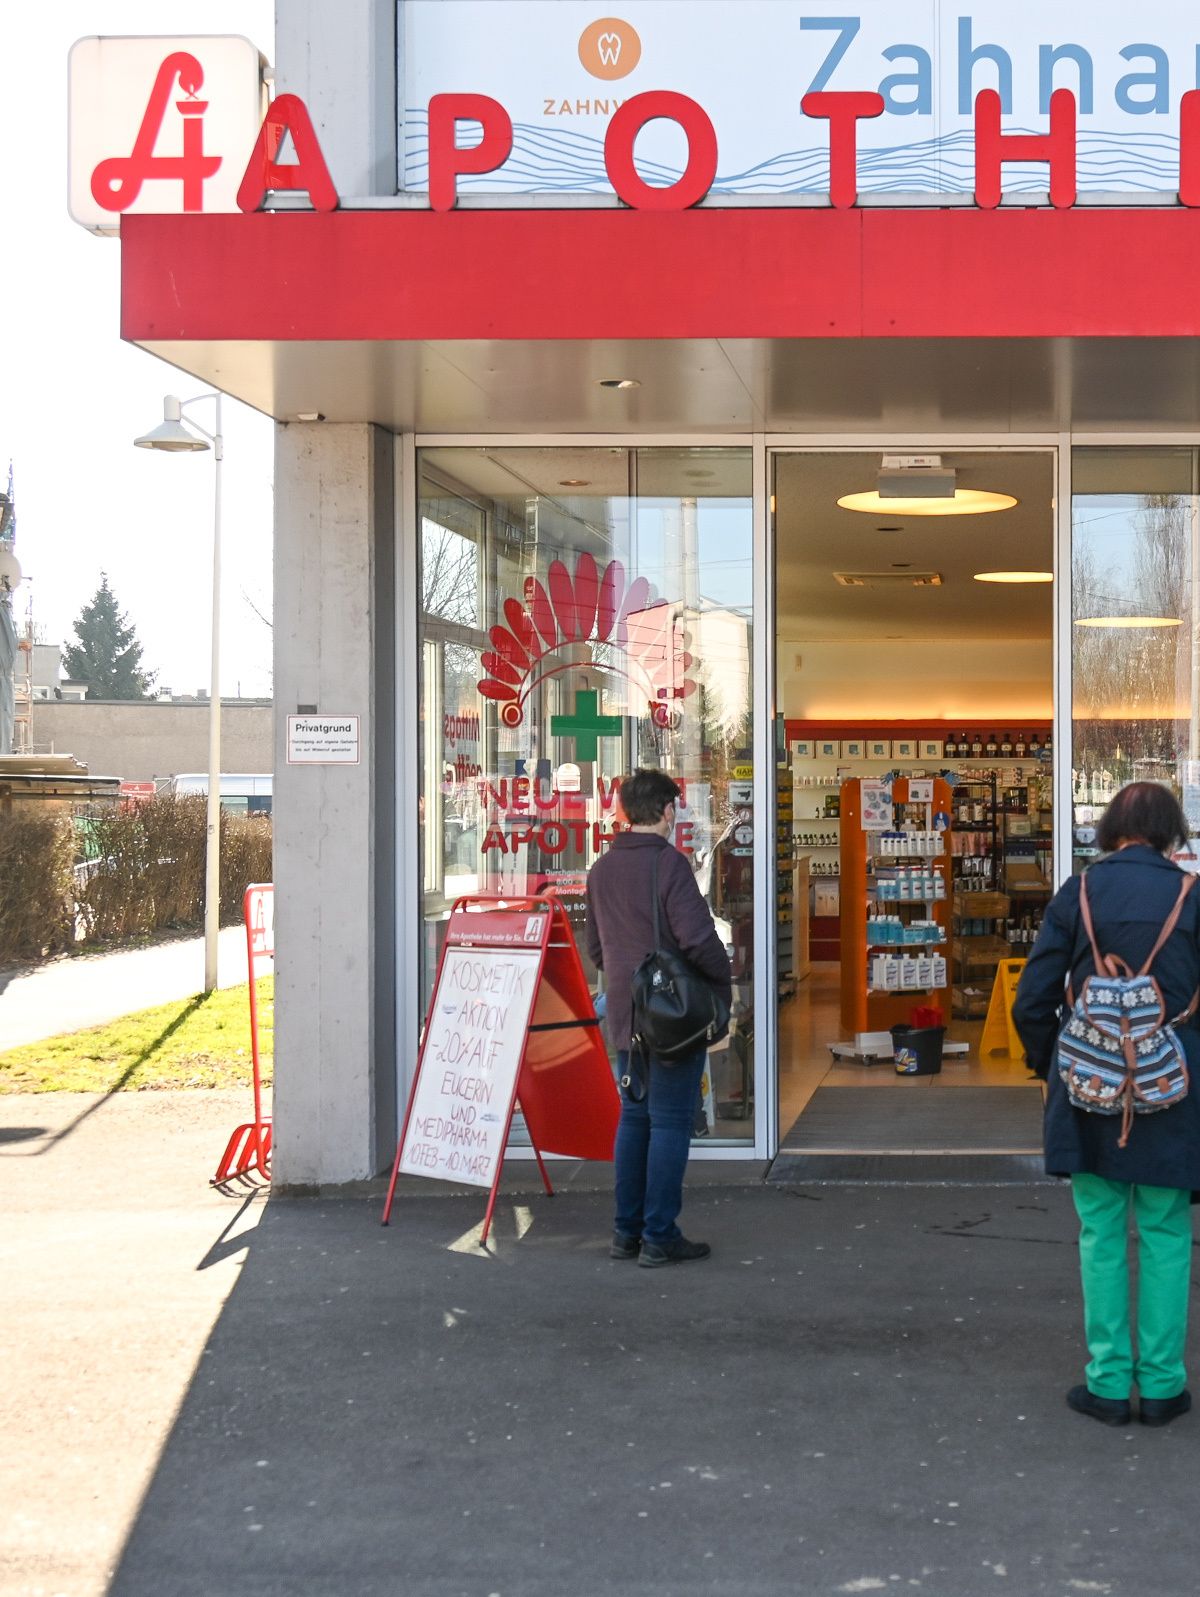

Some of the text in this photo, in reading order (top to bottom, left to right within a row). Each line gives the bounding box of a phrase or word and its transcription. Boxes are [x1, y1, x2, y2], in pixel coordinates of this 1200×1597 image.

[295, 723, 351, 734] Privatgrund
[479, 776, 689, 810] NEUE WT
[481, 821, 695, 854] APOTHE
[449, 961, 527, 996] KOSMETIK
[457, 1000, 508, 1031] AKTION
[440, 1071, 494, 1105] EUCERIN
[450, 1104, 477, 1126] UND
